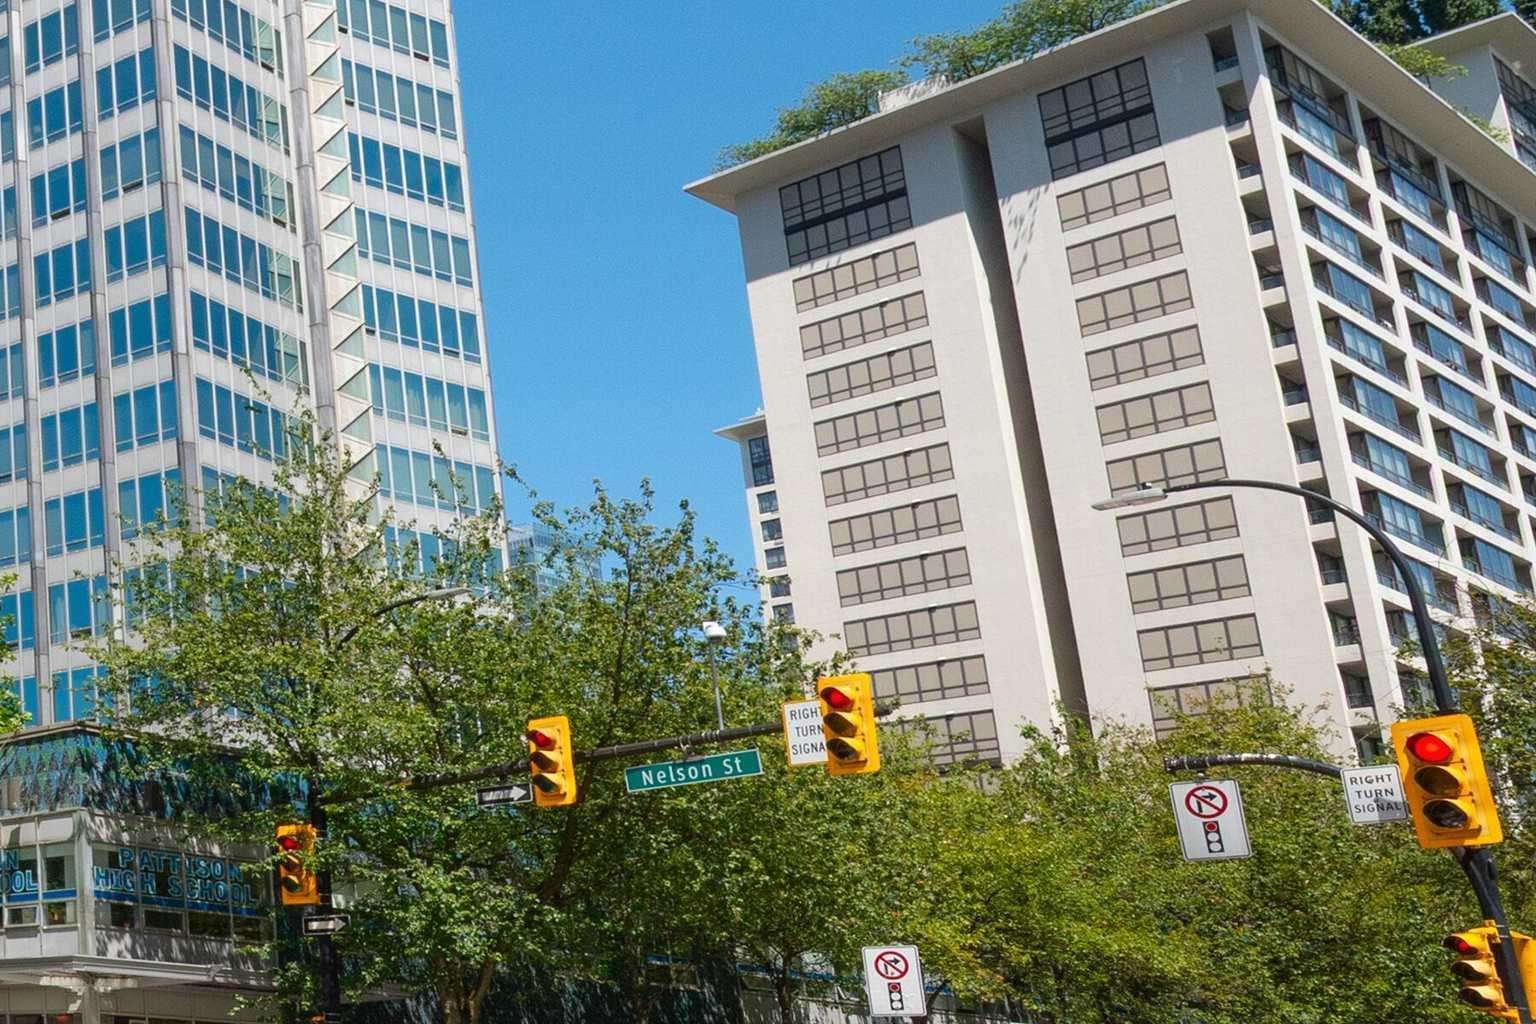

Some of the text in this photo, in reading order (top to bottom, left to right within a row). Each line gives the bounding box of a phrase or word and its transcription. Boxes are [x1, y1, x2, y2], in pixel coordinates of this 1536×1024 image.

[790, 707, 818, 721] RIGH
[791, 742, 826, 755] SIGNA
[641, 756, 743, 786] Nelson St
[1349, 773, 1393, 785] RIGHT
[1355, 788, 1395, 799] TURN
[1354, 802, 1402, 814] SIGNAL
[119, 848, 244, 882] PATTISON
[94, 865, 258, 904] HIGH SCHOOL
